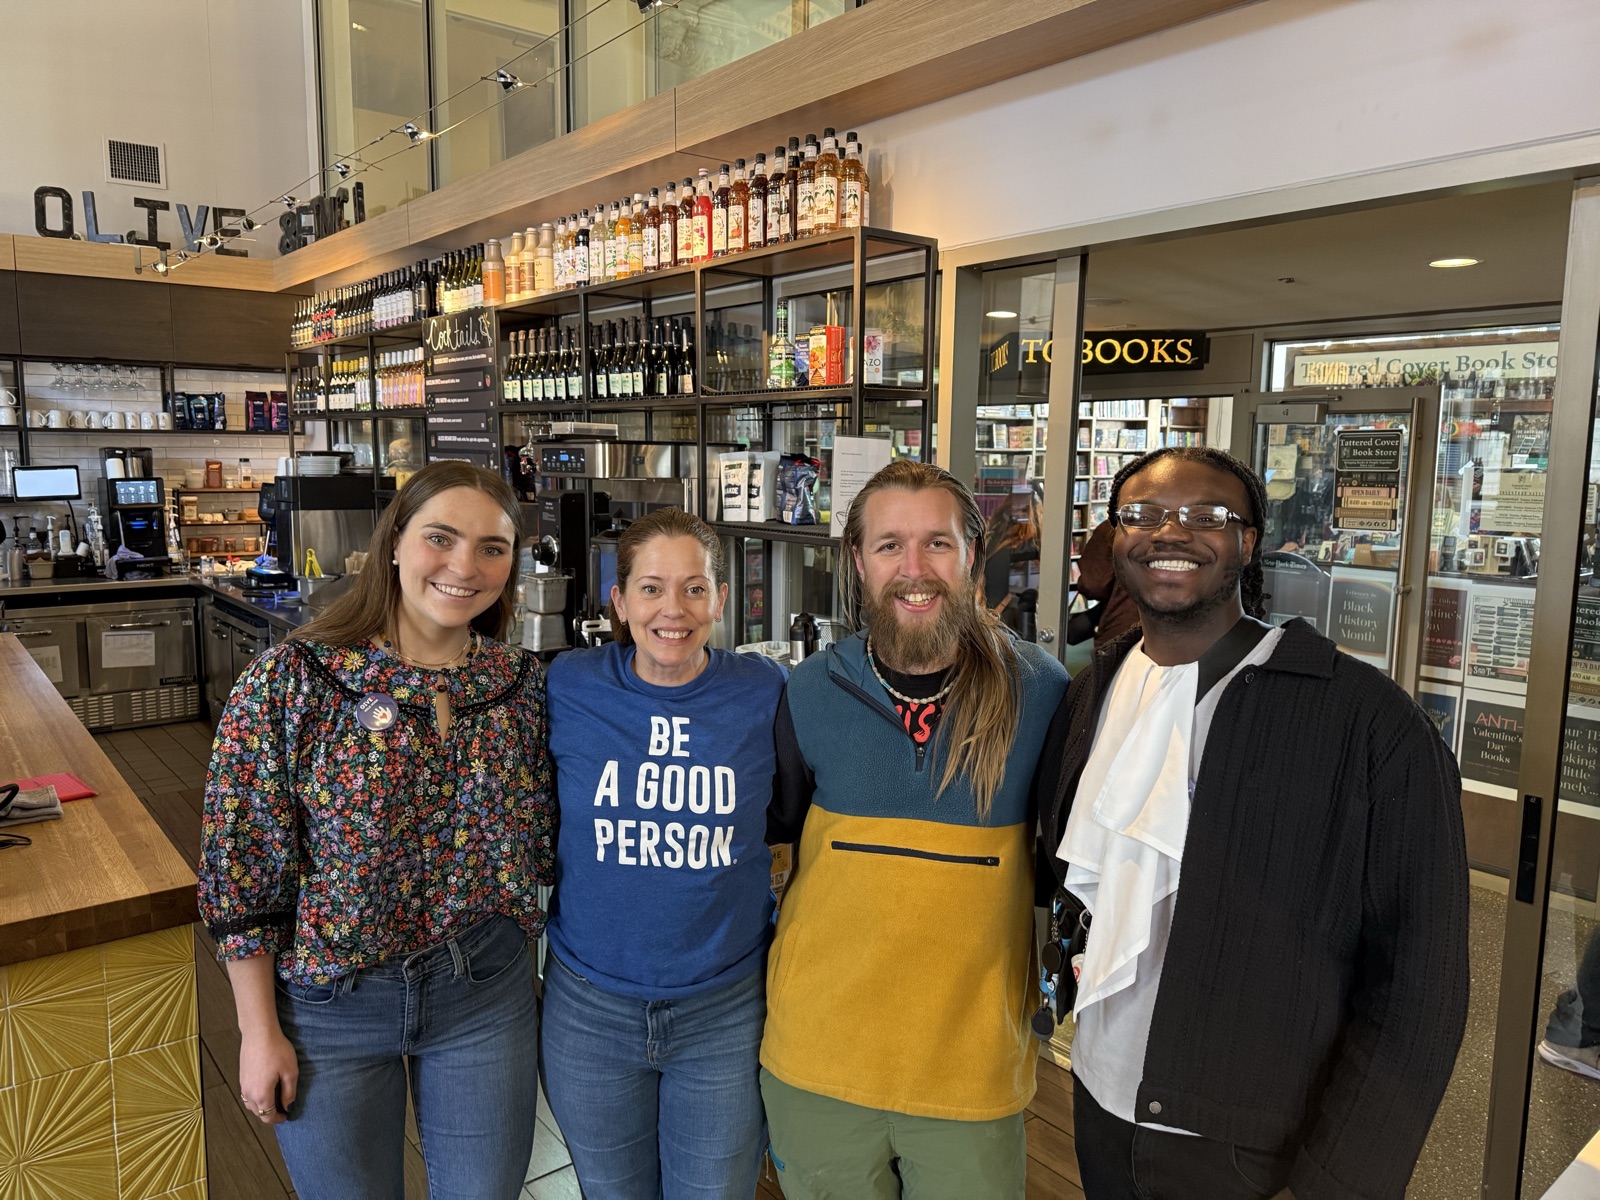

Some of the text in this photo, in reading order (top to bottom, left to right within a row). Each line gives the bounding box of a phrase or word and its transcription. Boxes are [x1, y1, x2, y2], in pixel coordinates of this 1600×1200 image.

[34, 185, 249, 257] OLIVE
[426, 316, 481, 351] Cocktails
[1386, 357, 1450, 377] Cover
[1456, 351, 1516, 373] Book
[1340, 438, 1399, 447] Tattered Cover
[1352, 448, 1398, 456] Book Store
[1365, 489, 1380, 497] DAILY
[1343, 600, 1374, 614] Black
[1338, 614, 1379, 631] History
[1341, 628, 1376, 642] Month
[1475, 712, 1523, 732] ANTI-
[648, 716, 690, 757] BE
[1472, 726, 1523, 743] Valentine's
[1487, 740, 1507, 753] Day
[1587, 743, 1598, 754] is
[1480, 750, 1511, 764] Books
[1563, 765, 1591, 780] little
[593, 760, 736, 814] A GOOD
